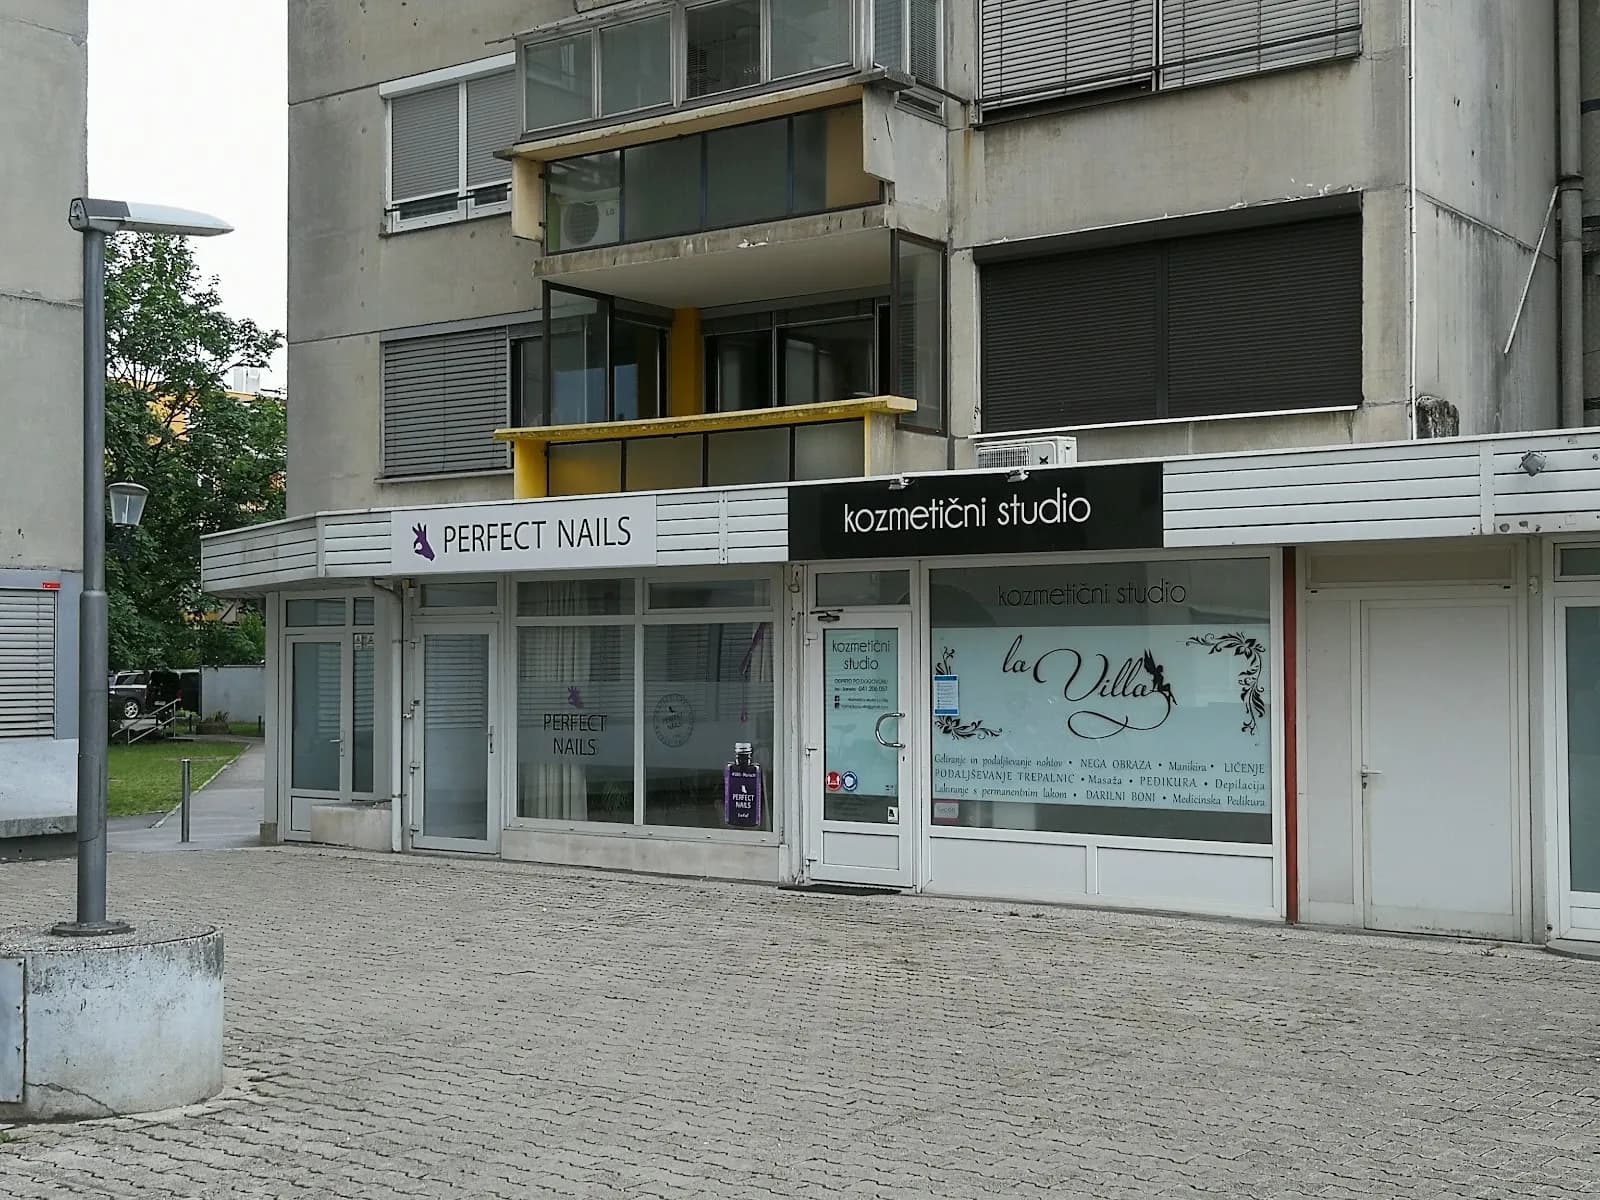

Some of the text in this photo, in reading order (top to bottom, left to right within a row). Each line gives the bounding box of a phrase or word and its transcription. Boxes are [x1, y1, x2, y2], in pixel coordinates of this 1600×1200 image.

[844, 487, 1092, 533] kozmetični studio
[444, 516, 632, 553] PERFECT NAILS
[998, 578, 1187, 607] kozmetični studio
[832, 639, 891, 653] kozmetični
[843, 655, 879, 670] studio
[1002, 634, 1158, 703] la Villa
[543, 713, 608, 732] PERFECT
[553, 737, 596, 756] NAILS
[970, 755, 978, 765] in
[1036, 756, 1063, 767] nohtov
[1080, 758, 1107, 769] NEGA
[1112, 759, 1152, 770] OBRAZA
[1224, 761, 1265, 777] LIČENJE
[935, 768, 1265, 793] PODALJŠEVANJE TREPALNIC Masaža PEDIKURA Depilacija
[735, 802, 752, 810] NAILS
[1043, 787, 1067, 799] lakom
[1086, 790, 1125, 801] DARILNI
[1131, 791, 1155, 802] BONI
[1173, 793, 1221, 805] Medicinska
[1227, 794, 1265, 807] Pedikura
